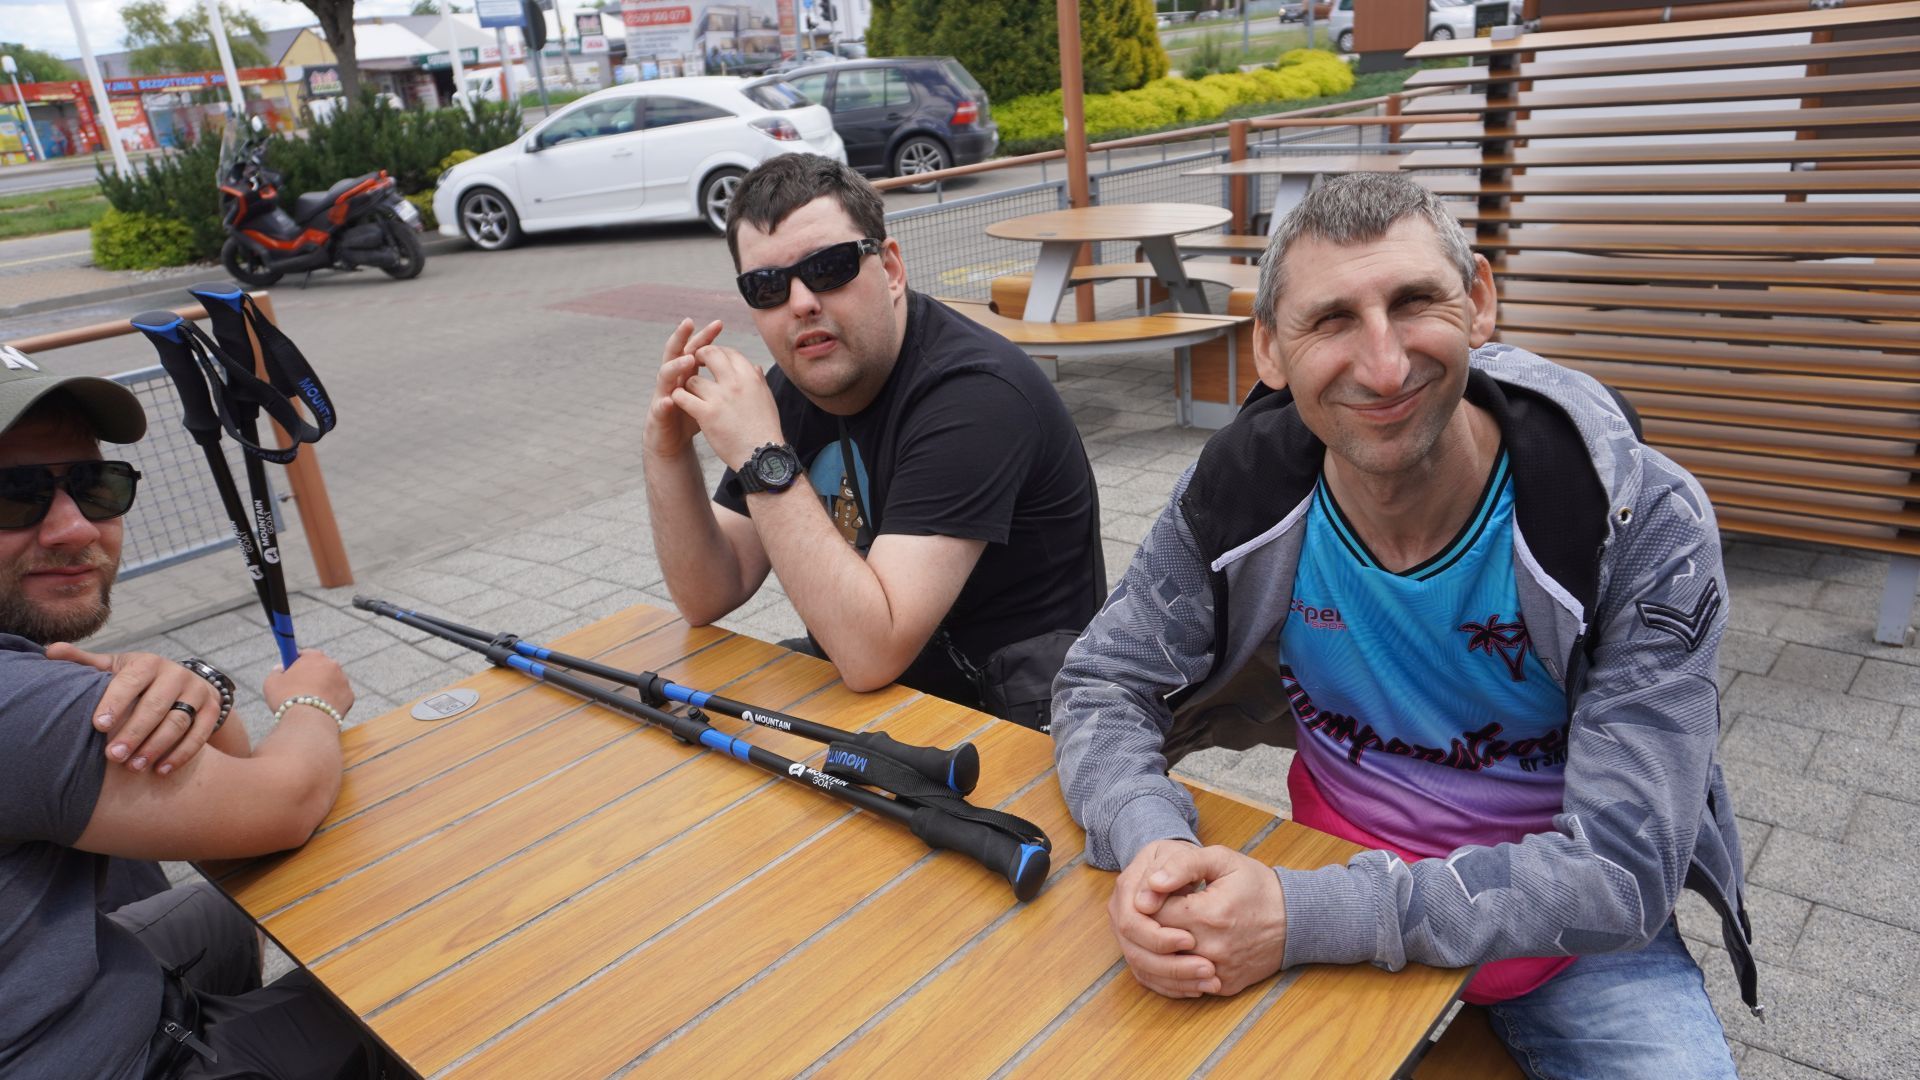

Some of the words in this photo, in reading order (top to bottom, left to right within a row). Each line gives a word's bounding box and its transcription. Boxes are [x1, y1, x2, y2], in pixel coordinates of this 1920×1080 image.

[254, 499, 270, 547] MOUNTAIN
[264, 511, 274, 534] GOAT
[240, 531, 254, 553] GOAT
[754, 713, 792, 731] MOUNTAIN
[806, 767, 849, 787] MOUNTAIN
